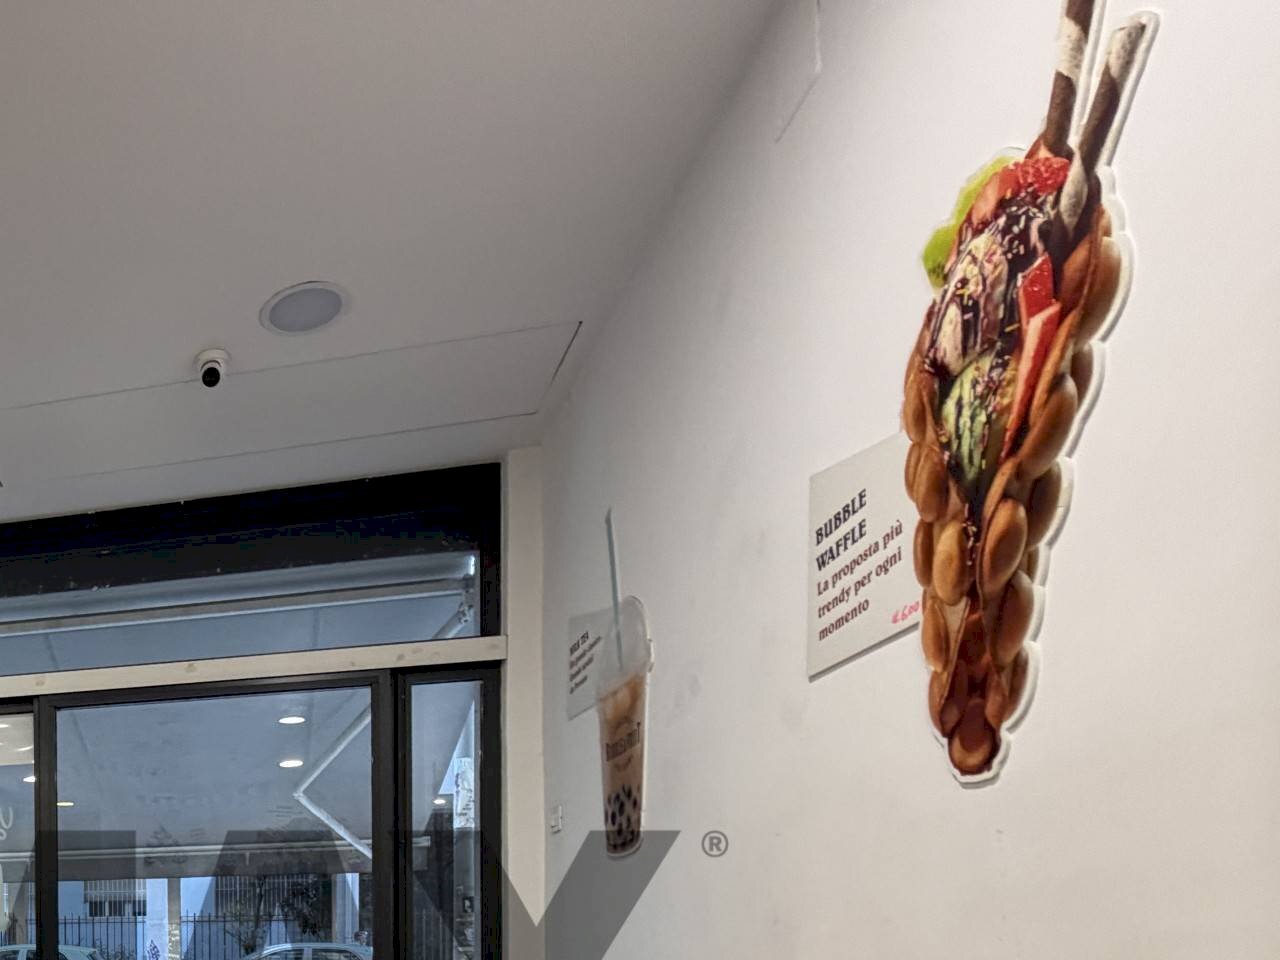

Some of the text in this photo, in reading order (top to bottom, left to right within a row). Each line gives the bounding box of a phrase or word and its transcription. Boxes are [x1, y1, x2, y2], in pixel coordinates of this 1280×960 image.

[815, 488, 867, 547] BUBBLE
[816, 518, 867, 571] WAFFLE
[817, 519, 903, 597] La proposta più
[818, 546, 902, 618] trendy per ogni
[819, 598, 870, 642] momento
